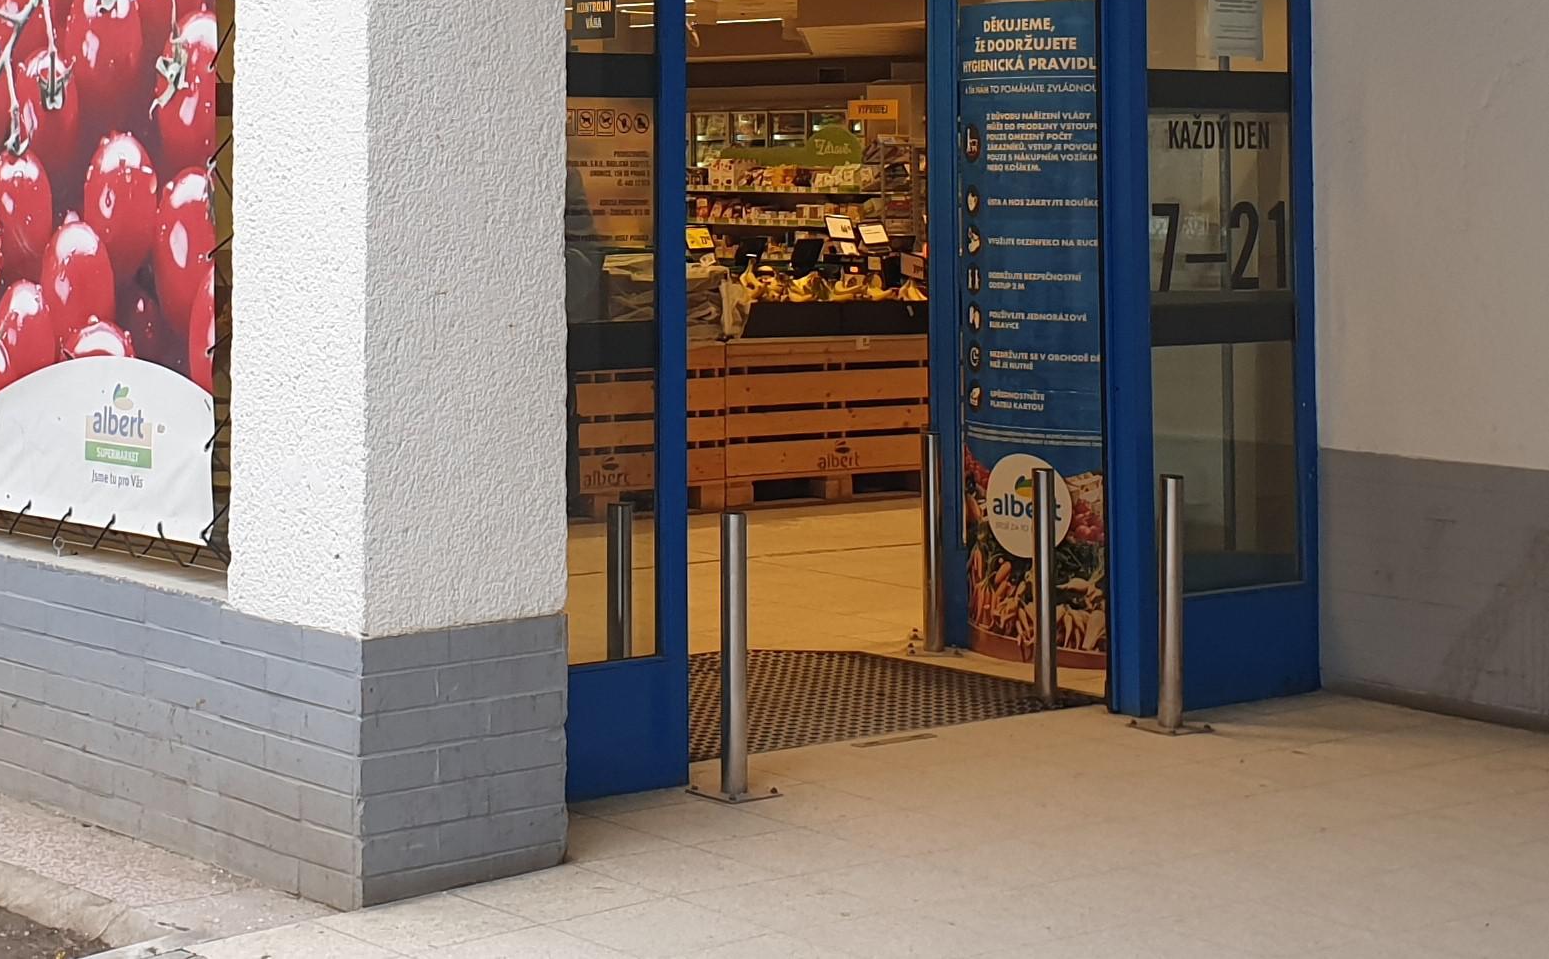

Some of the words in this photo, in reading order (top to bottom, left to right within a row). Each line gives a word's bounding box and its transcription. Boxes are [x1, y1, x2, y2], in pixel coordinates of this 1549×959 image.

[983, 16, 1056, 33] DĚKUJEME,
[975, 37, 986, 53] ŽE
[987, 35, 1077, 52] DODRŽUJETE
[963, 54, 1025, 73] HYGIENICKÁ
[1168, 114, 1230, 150] KAŽDÝ
[1234, 121, 1270, 150] DEN
[92, 405, 144, 439] albert
[817, 451, 860, 470] albert
[92, 469, 108, 483] Jsme
[110, 472, 116, 485] tu
[118, 476, 129, 489] pro
[993, 492, 1062, 522] albet
